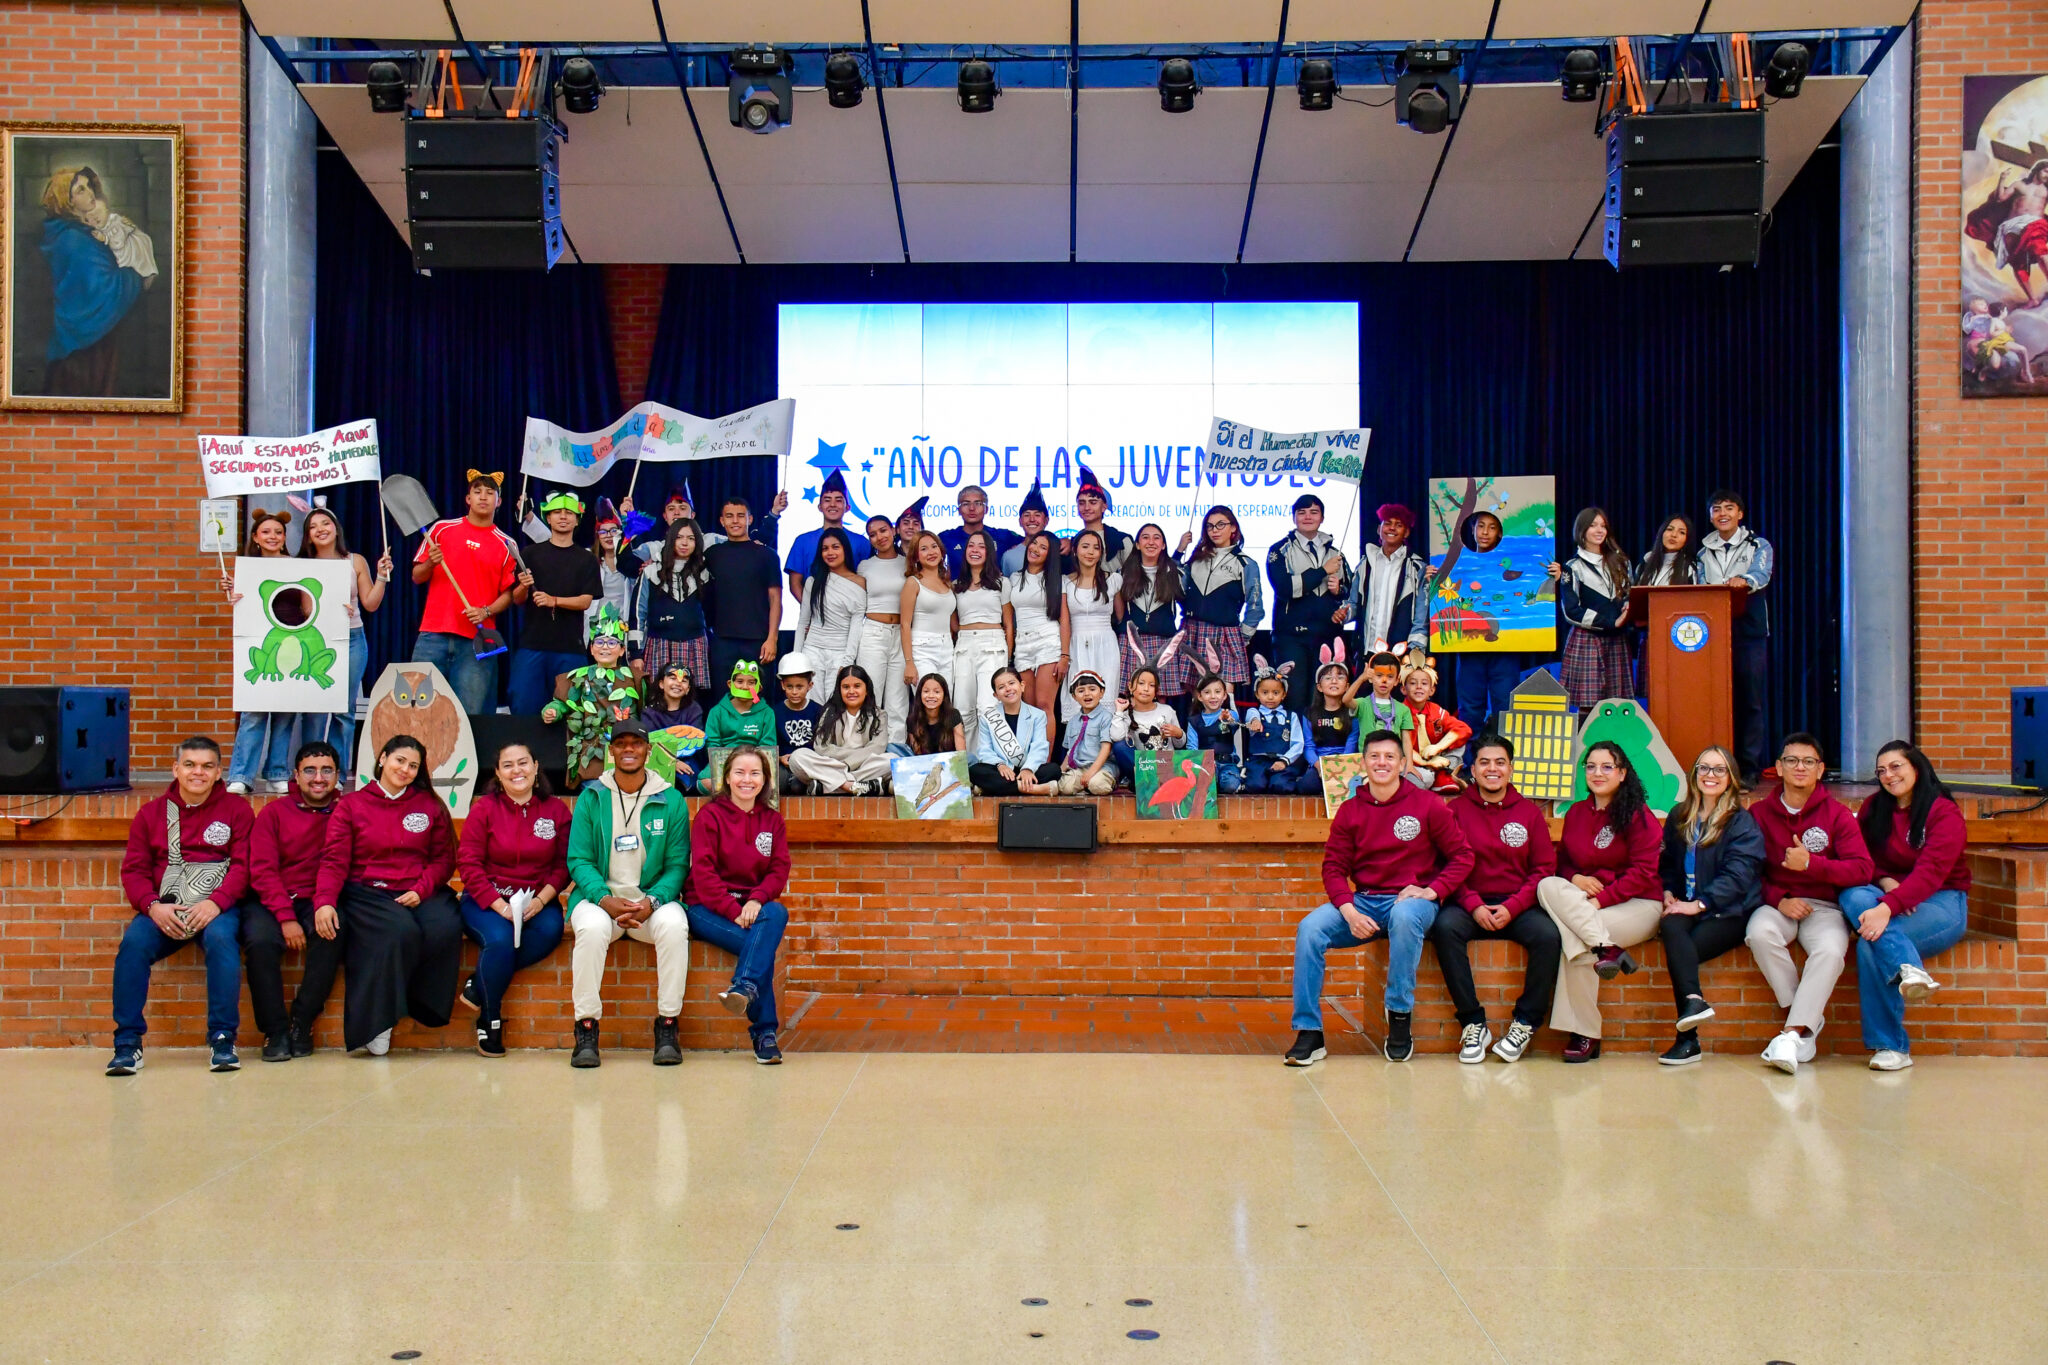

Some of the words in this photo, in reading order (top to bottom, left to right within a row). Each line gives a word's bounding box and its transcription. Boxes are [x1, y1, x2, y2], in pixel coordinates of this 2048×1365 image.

[1238, 428, 1254, 450] el
[1259, 431, 1318, 451] Humedal
[294, 456, 320, 472] LOS
[328, 444, 379, 464] HUMEDALE
[979, 445, 1020, 488] DE
[1036, 445, 1092, 488] LAS
[1208, 451, 1268, 471] nuestra
[1271, 450, 1318, 473] ciudad
[1000, 504, 1018, 517] LOS
[1159, 504, 1171, 517] DE
[1175, 504, 1190, 517] UN
[1237, 504, 1293, 517] ESPERANZ
